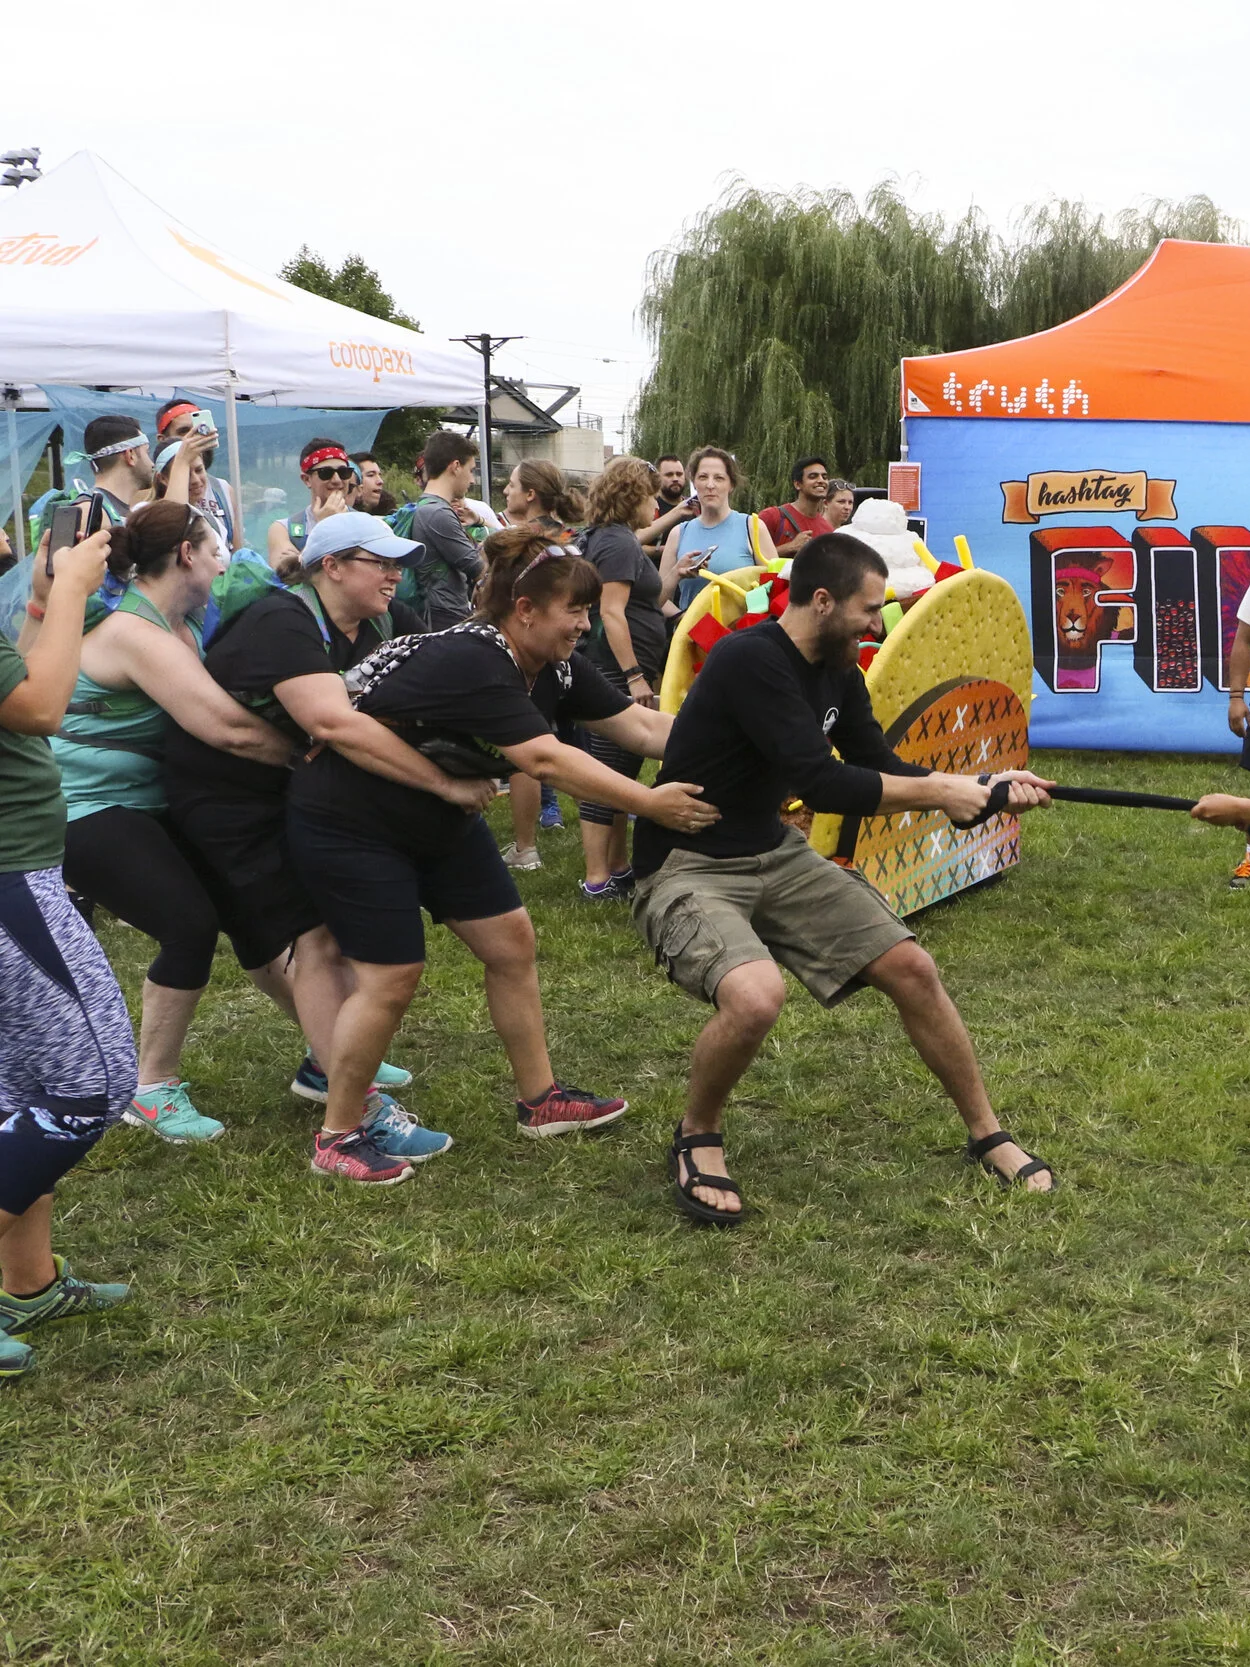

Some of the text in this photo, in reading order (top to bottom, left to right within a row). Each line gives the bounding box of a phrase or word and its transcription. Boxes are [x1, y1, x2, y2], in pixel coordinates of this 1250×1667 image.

[328, 339, 416, 383] cotopaxi
[943, 371, 1089, 415] truth
[1037, 475, 1136, 508] hashtag
